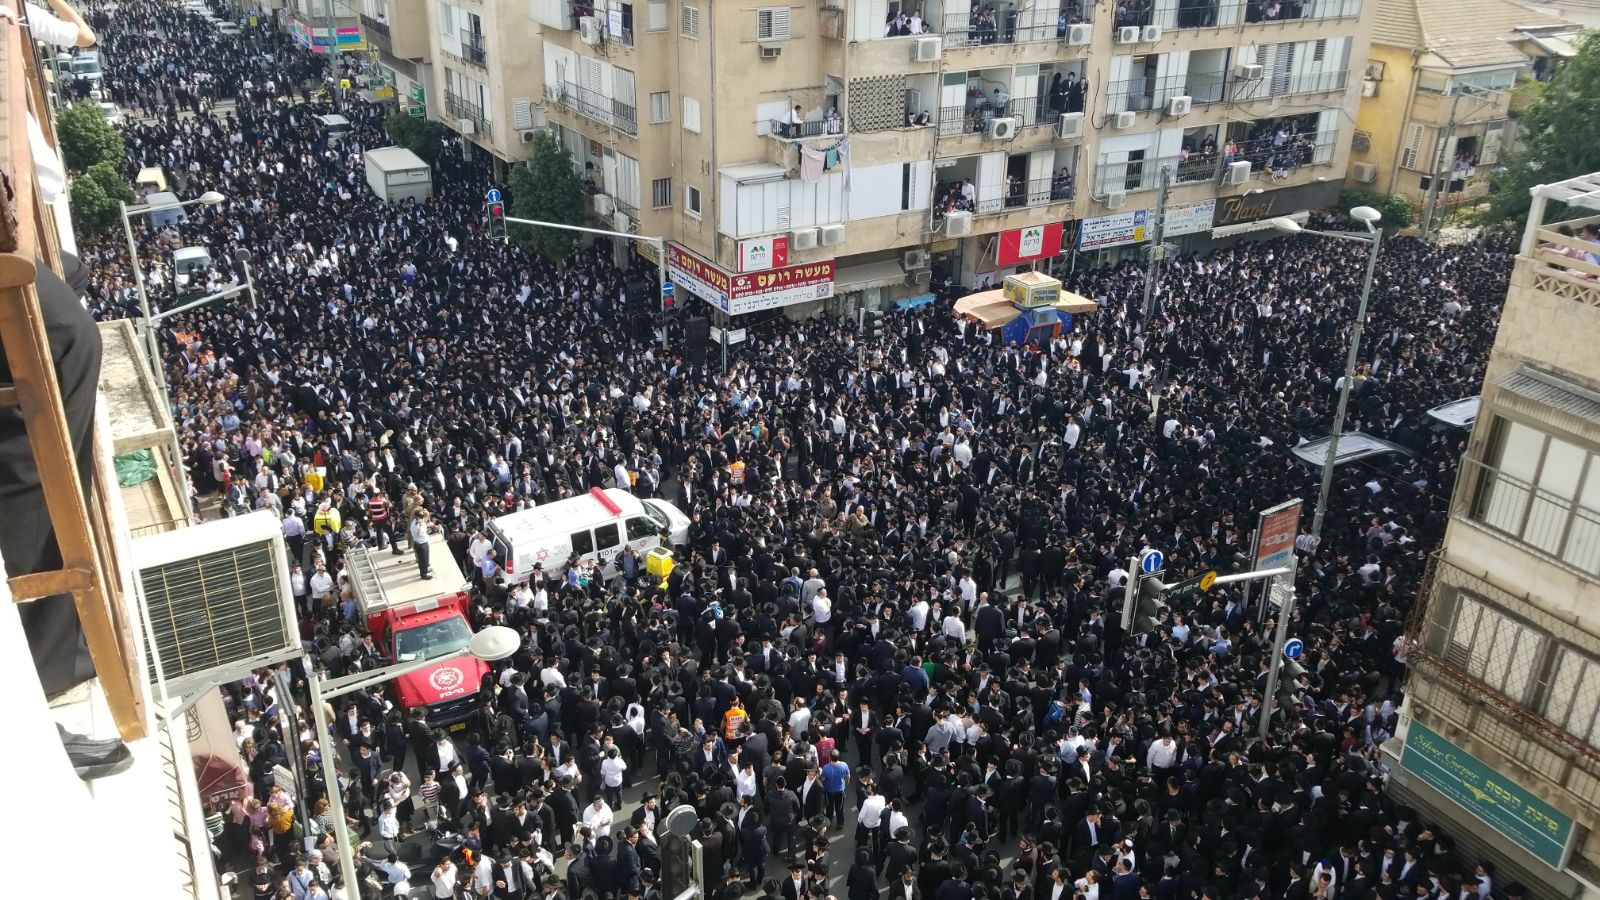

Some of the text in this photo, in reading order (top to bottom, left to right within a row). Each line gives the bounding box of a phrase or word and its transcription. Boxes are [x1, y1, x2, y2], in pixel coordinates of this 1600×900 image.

[681, 254, 701, 275] רוקם
[794, 264, 831, 280] מעשה
[704, 266, 729, 291] מעשה
[757, 271, 791, 288] רוקם
[733, 296, 779, 312] טליתניה
[1414, 734, 1444, 756] Silver
[1444, 753, 1480, 779] Corner
[1485, 780, 1522, 806] הכסף
[1525, 805, 1559, 832] פינת
